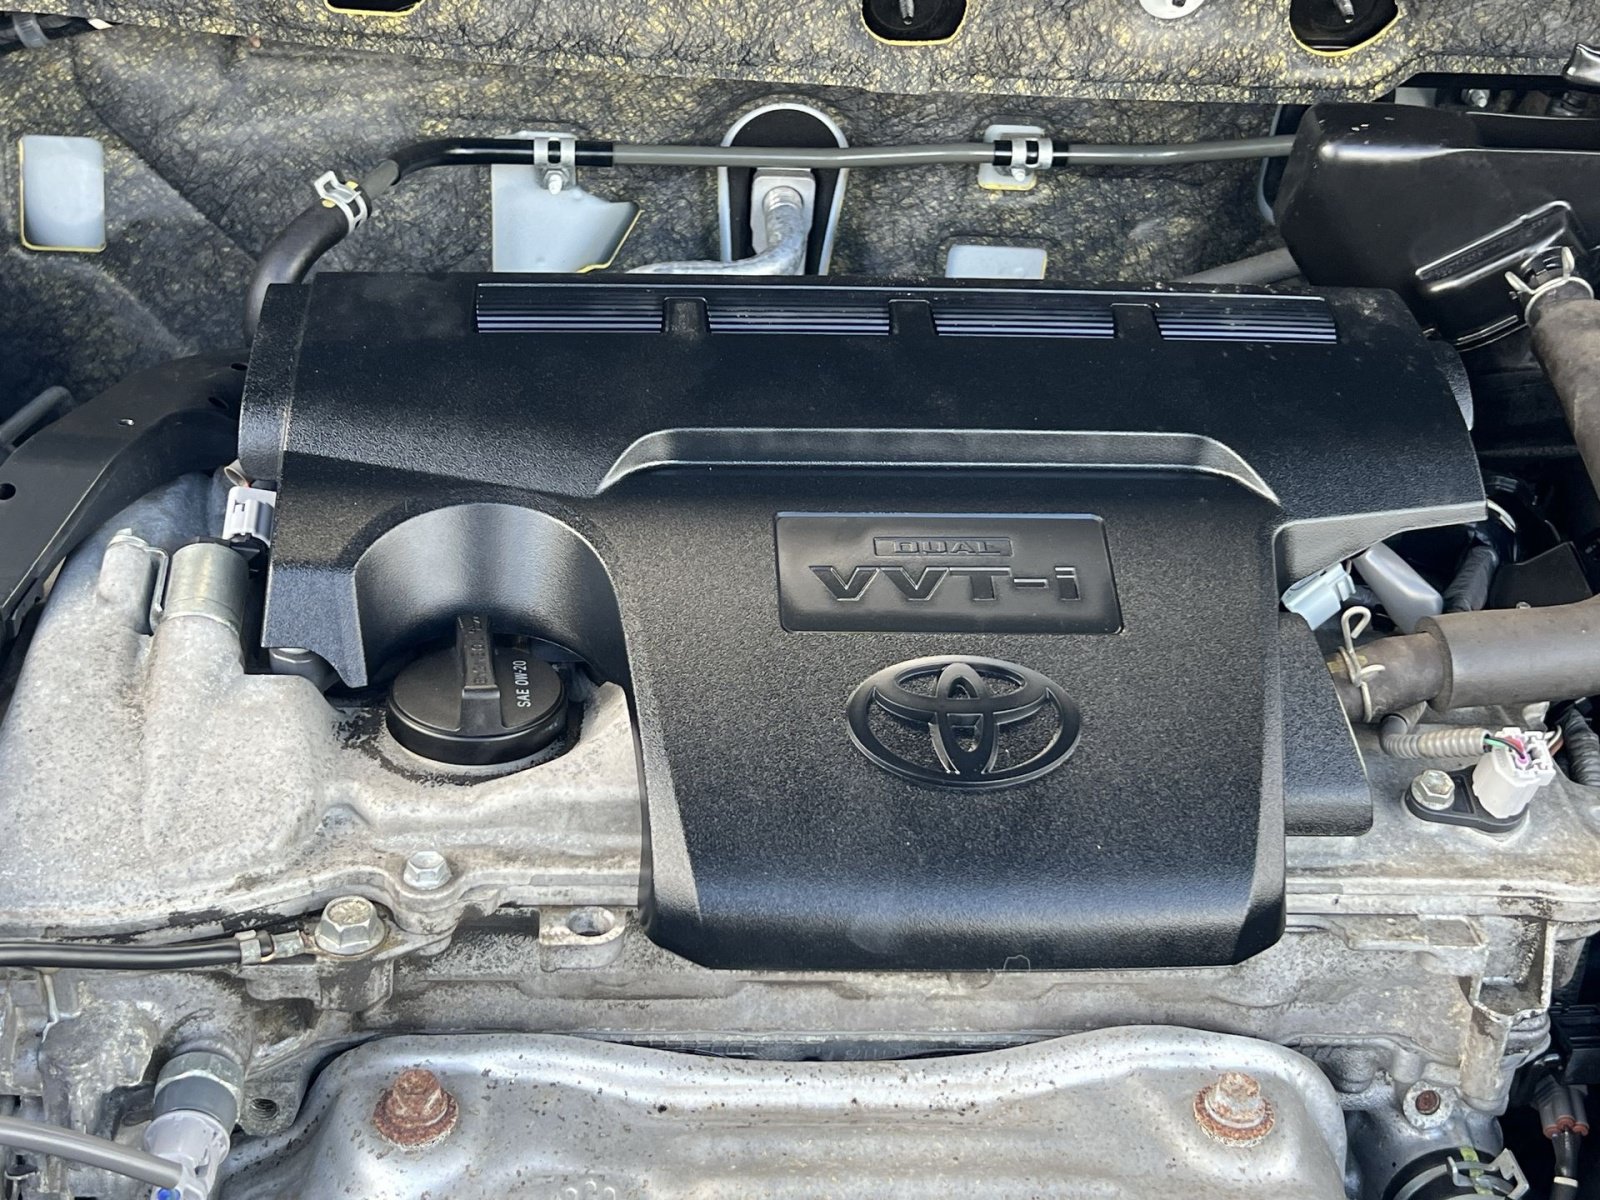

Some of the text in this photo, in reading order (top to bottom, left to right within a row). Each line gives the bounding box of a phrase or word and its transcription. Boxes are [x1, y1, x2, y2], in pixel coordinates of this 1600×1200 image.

[893, 540, 1001, 555] DUAL
[808, 565, 1082, 601] VVT-i
[512, 660, 531, 708] SAE 0W-20
